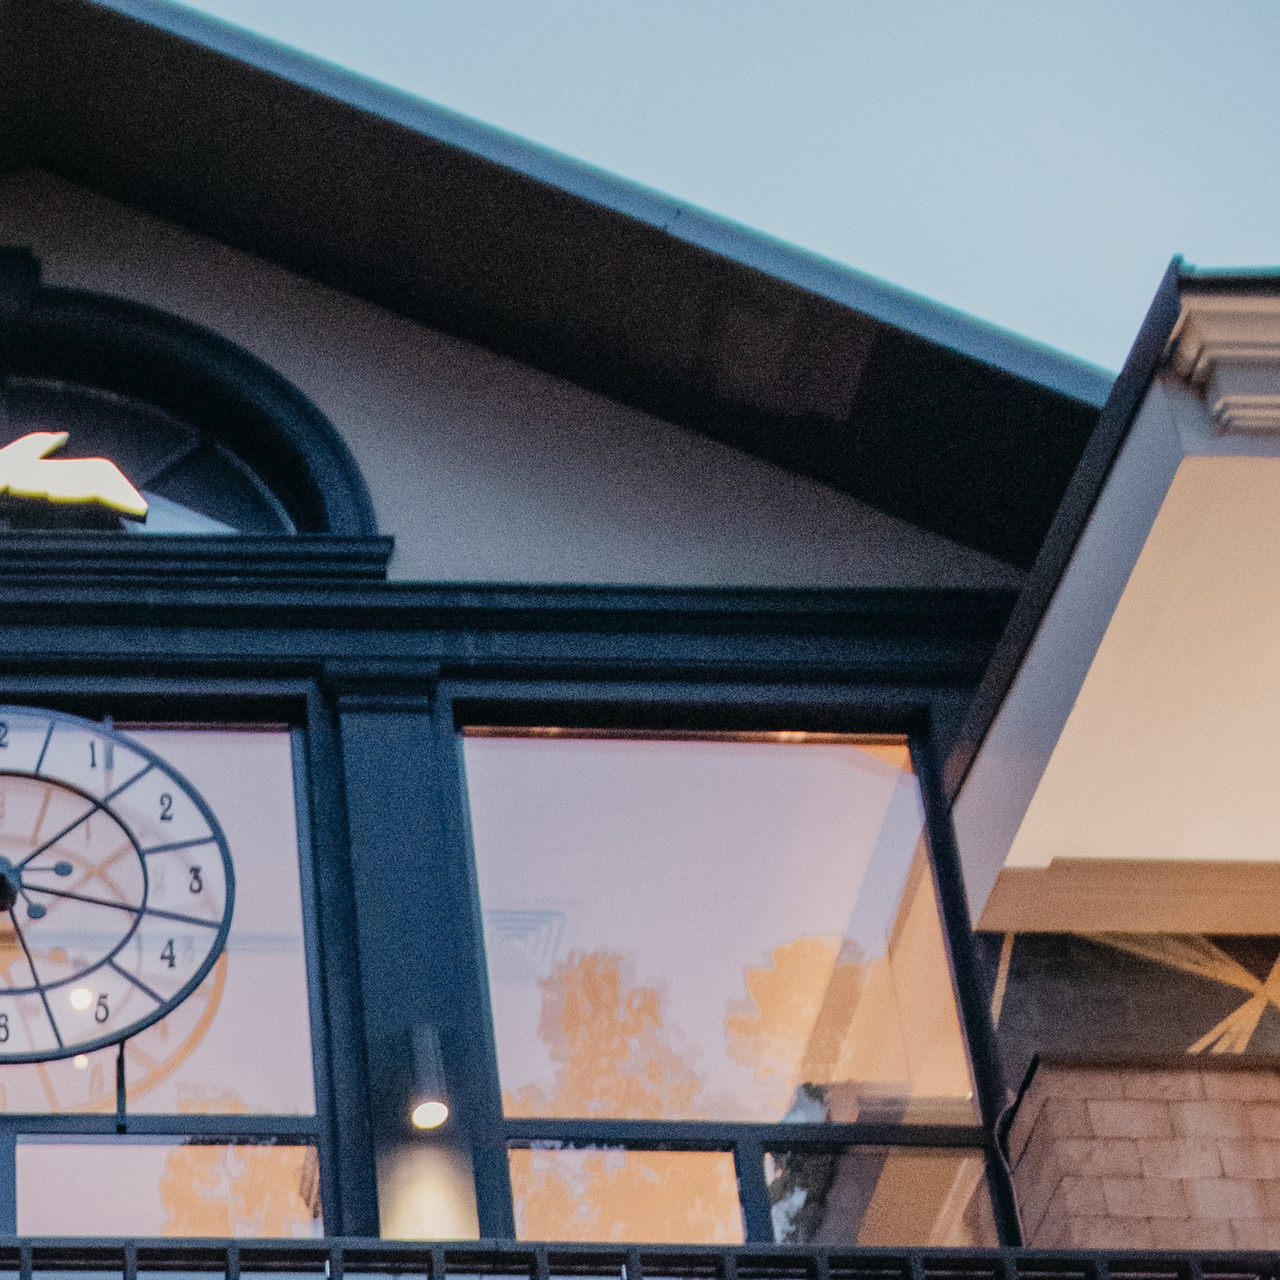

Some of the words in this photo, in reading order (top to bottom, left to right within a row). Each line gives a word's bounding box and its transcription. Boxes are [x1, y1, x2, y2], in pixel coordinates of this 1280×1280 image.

[159, 794, 173, 821] 2
[189, 866, 204, 893] 3
[160, 940, 176, 968] 4
[95, 994, 110, 1022] 5
